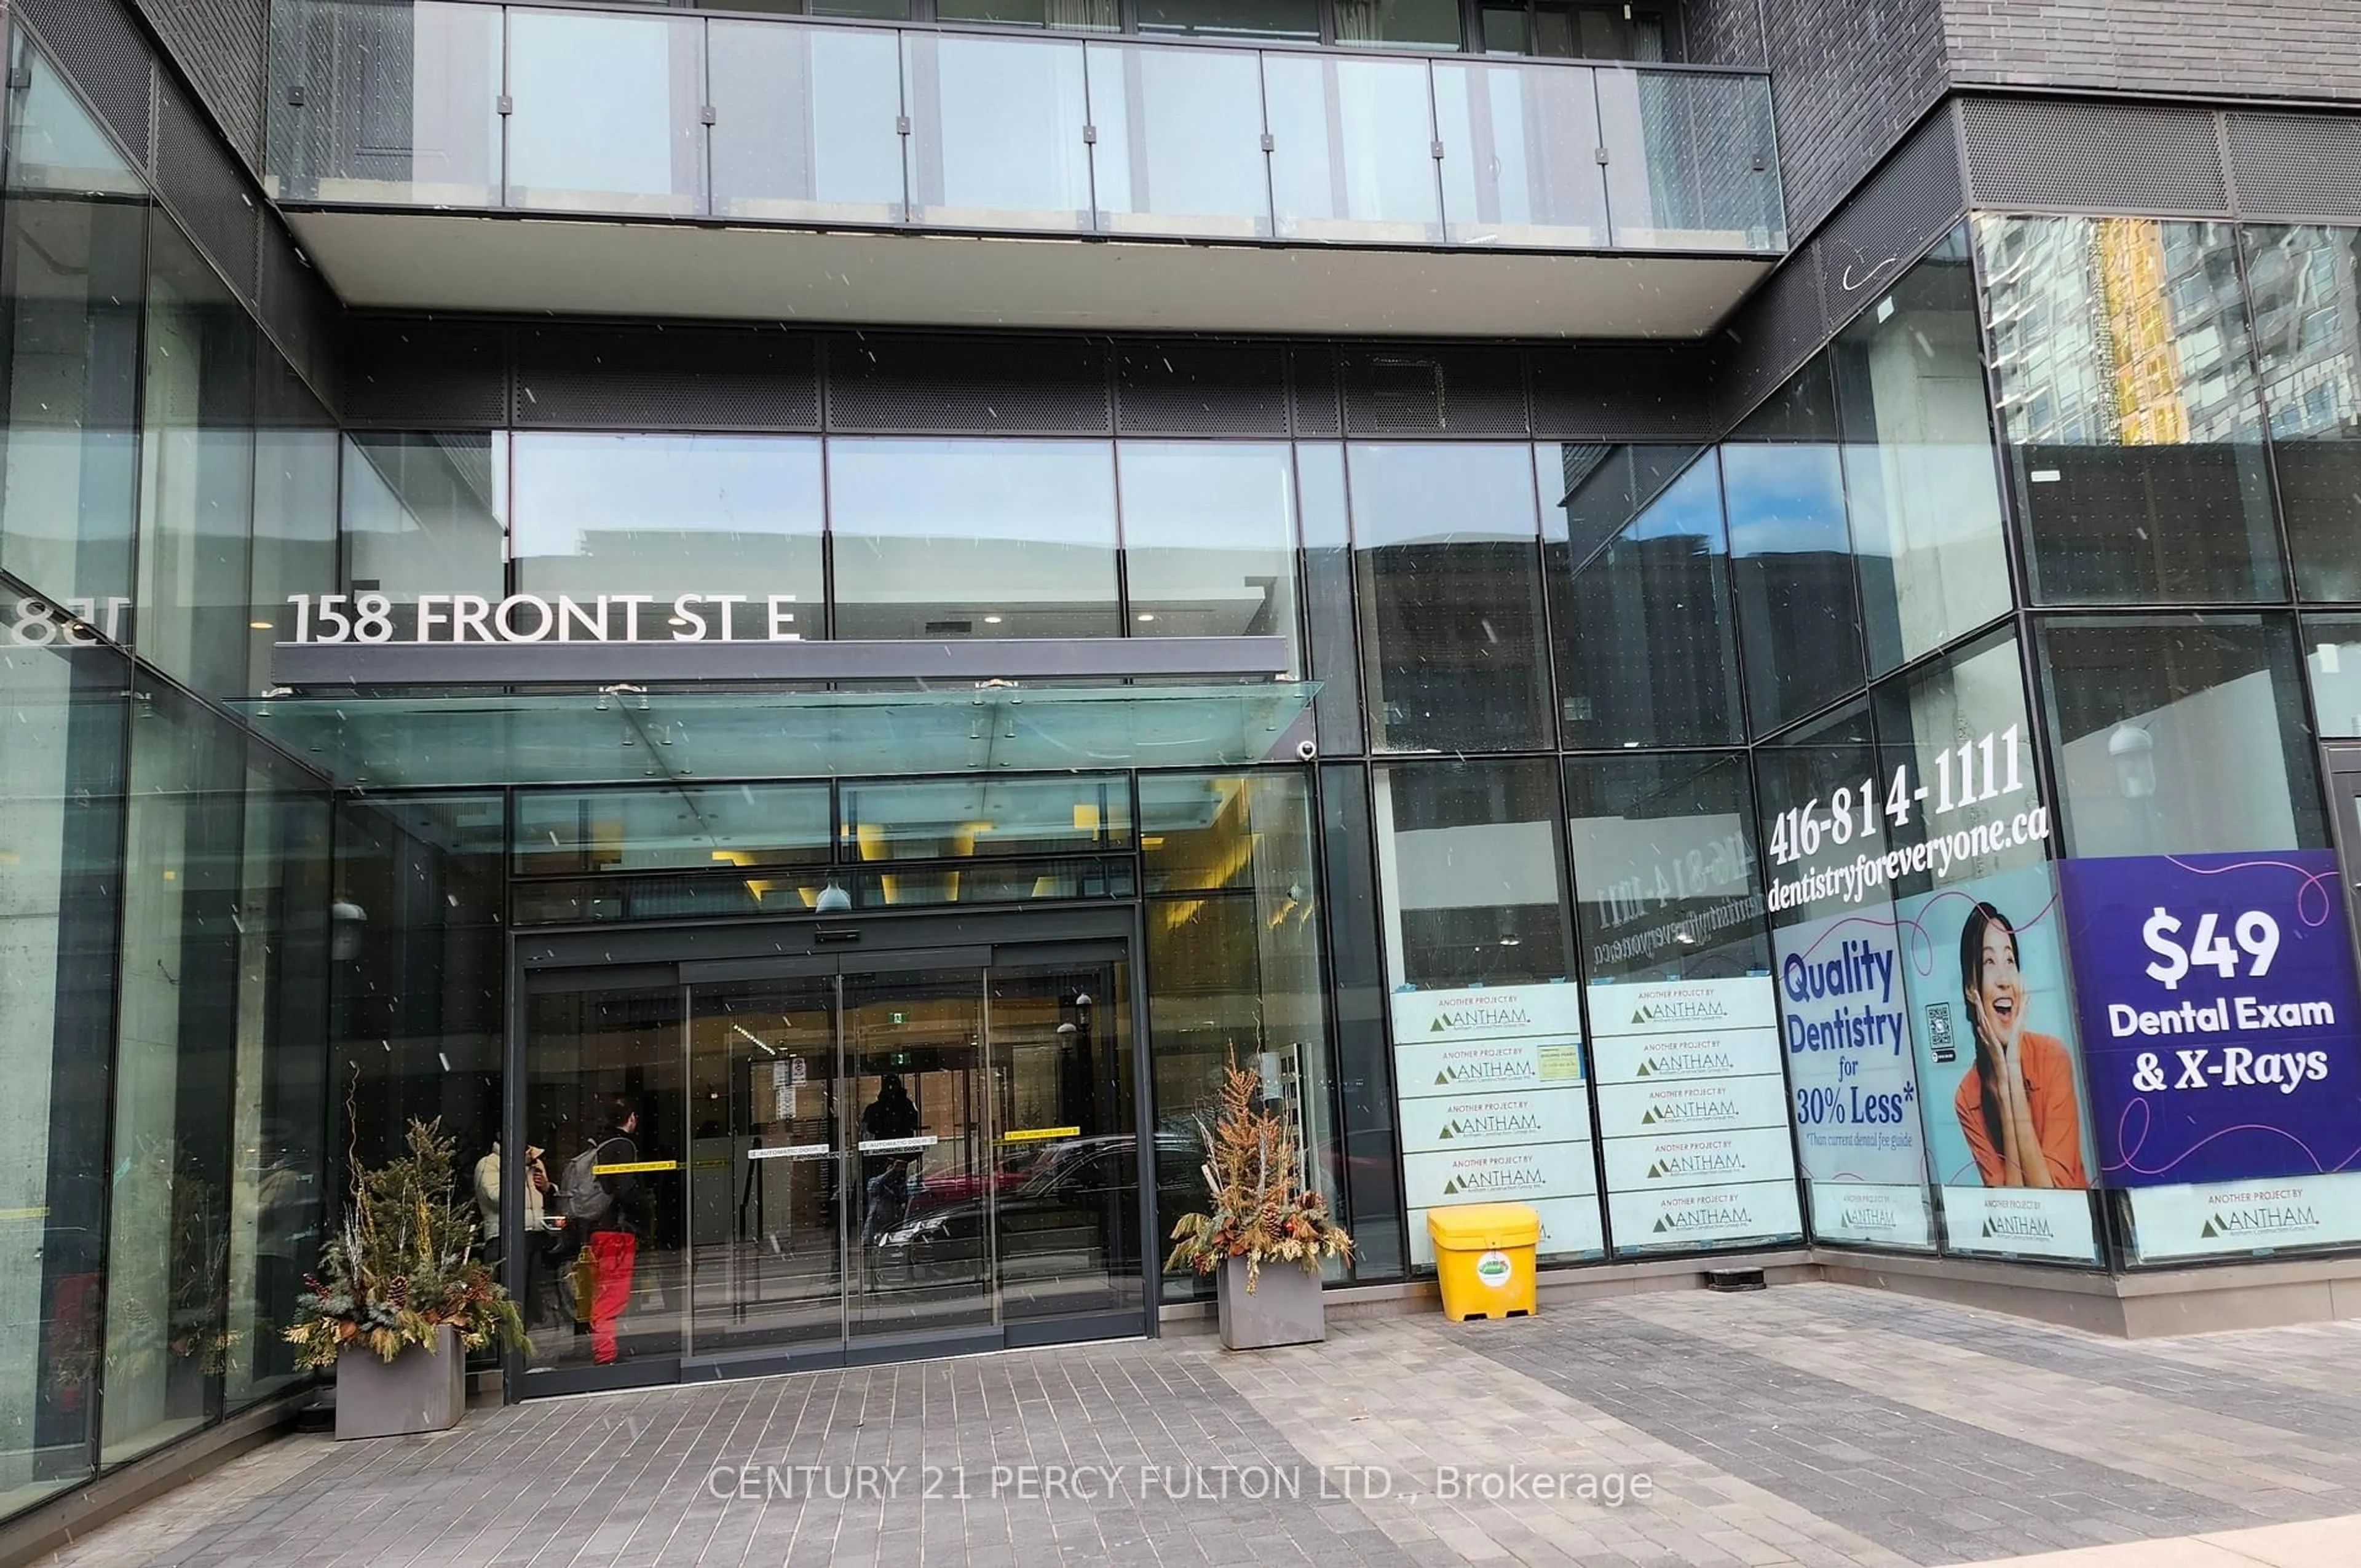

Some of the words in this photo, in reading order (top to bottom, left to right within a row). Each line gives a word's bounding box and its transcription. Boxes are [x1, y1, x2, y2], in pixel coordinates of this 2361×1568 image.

[287, 593, 393, 642] 158
[417, 593, 653, 641] FRONT
[673, 593, 747, 641] ST
[768, 595, 800, 641] E
[1768, 806, 2049, 912] dentistryforeveryone.ca
[1784, 940, 1892, 1003] Quality
[2143, 906, 2280, 989] $49
[1787, 1005, 1902, 1056] Dentistry
[2108, 997, 2230, 1037] Dental
[2234, 996, 2335, 1030] Exam
[1838, 1056, 1858, 1082] for
[2132, 1052, 2168, 1092] &
[2174, 1047, 2328, 1094] X-Rays
[1797, 1087, 1845, 1124] 30%
[1878, 1132, 1890, 1150] fee
[1891, 1133, 1912, 1150] guide
